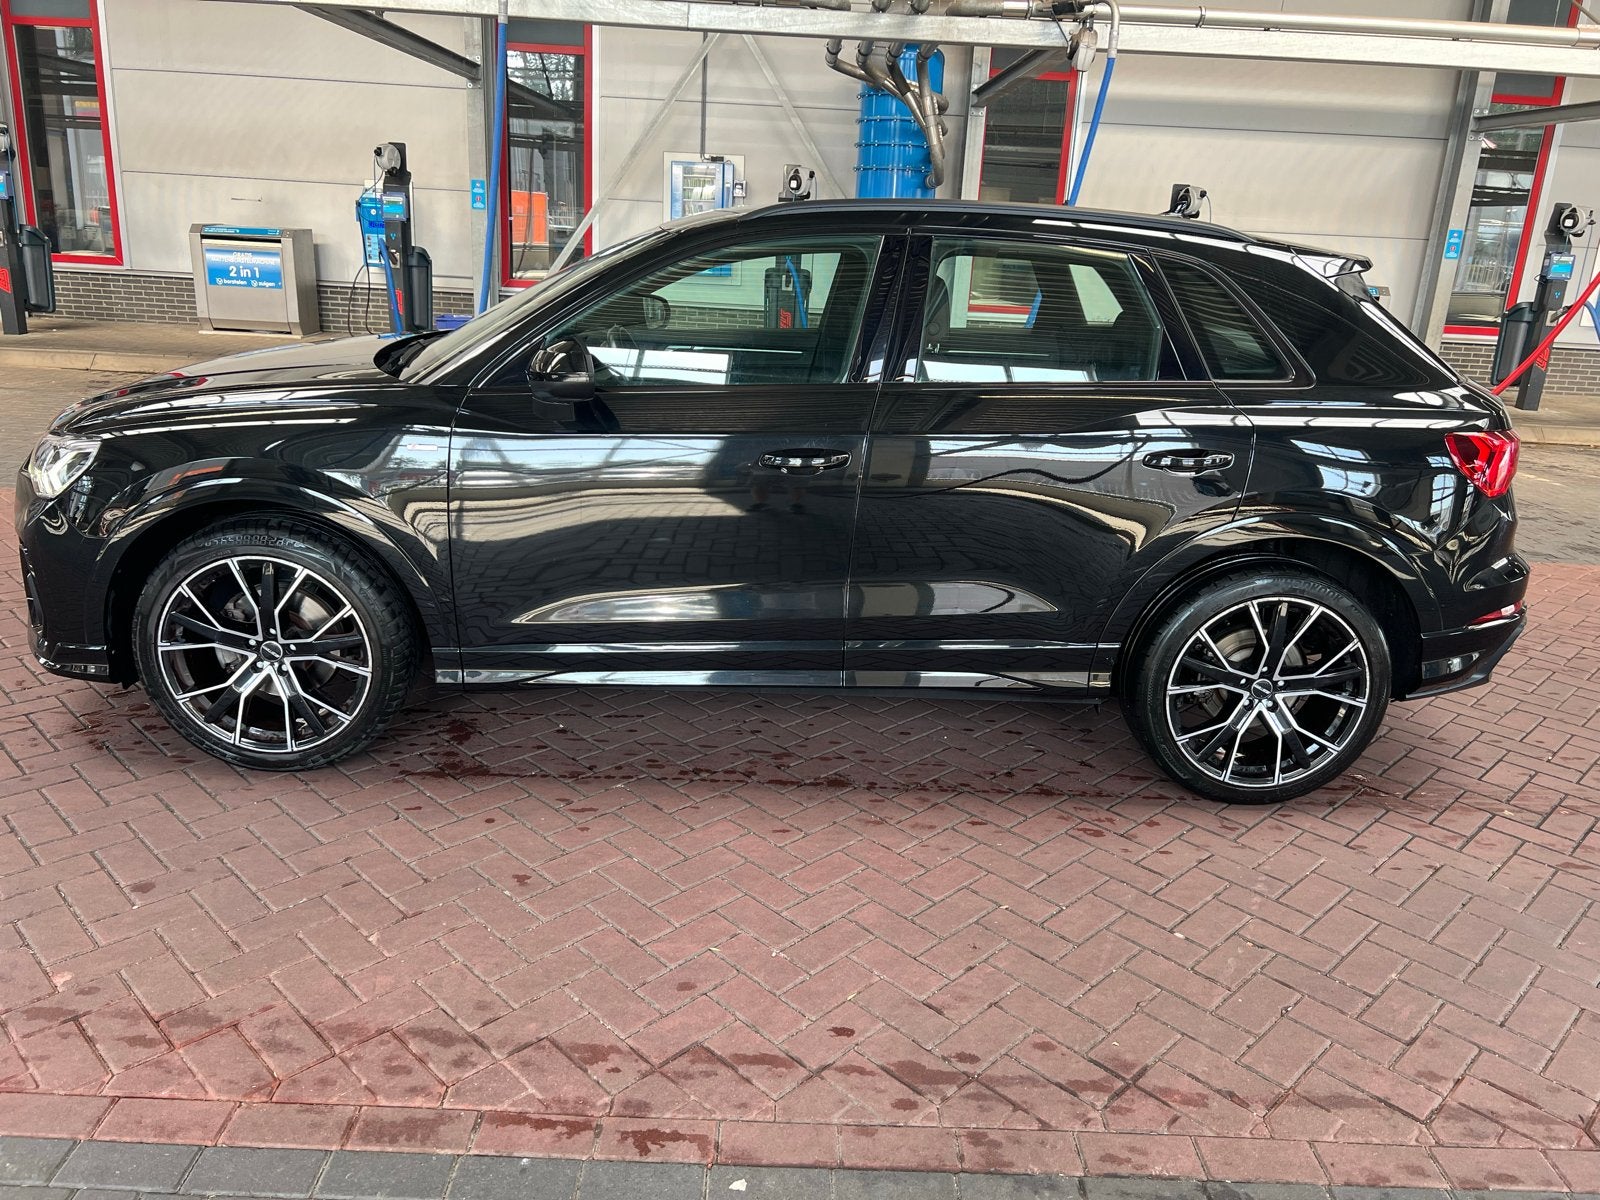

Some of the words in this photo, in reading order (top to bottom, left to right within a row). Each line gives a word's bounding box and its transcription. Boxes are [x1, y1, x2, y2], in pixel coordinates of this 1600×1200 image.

[229, 266, 237, 277] 2
[239, 266, 251, 278] in
[253, 267, 260, 278] 1
